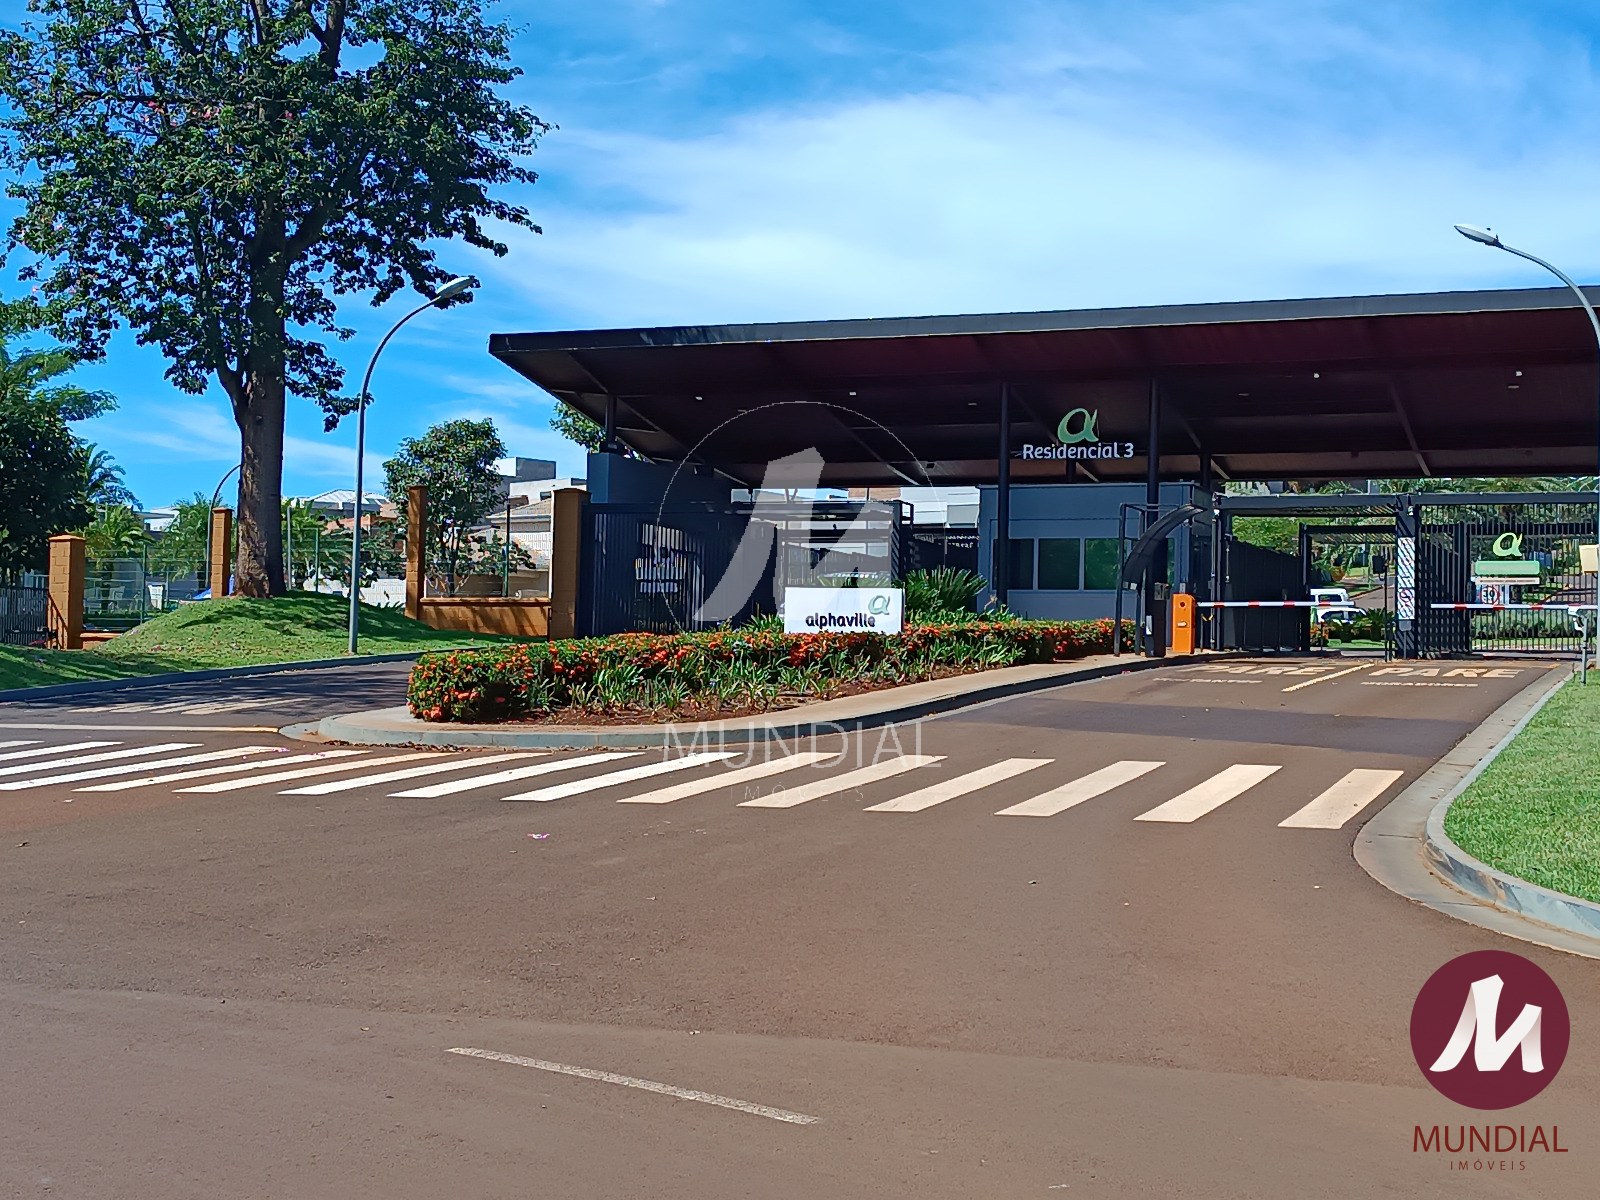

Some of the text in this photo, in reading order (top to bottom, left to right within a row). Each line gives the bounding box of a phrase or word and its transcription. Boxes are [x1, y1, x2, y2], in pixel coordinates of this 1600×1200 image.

[1023, 442, 1134, 459] Residencial 3
[805, 612, 876, 629] alphaville
[1369, 667, 1525, 678] PARE
